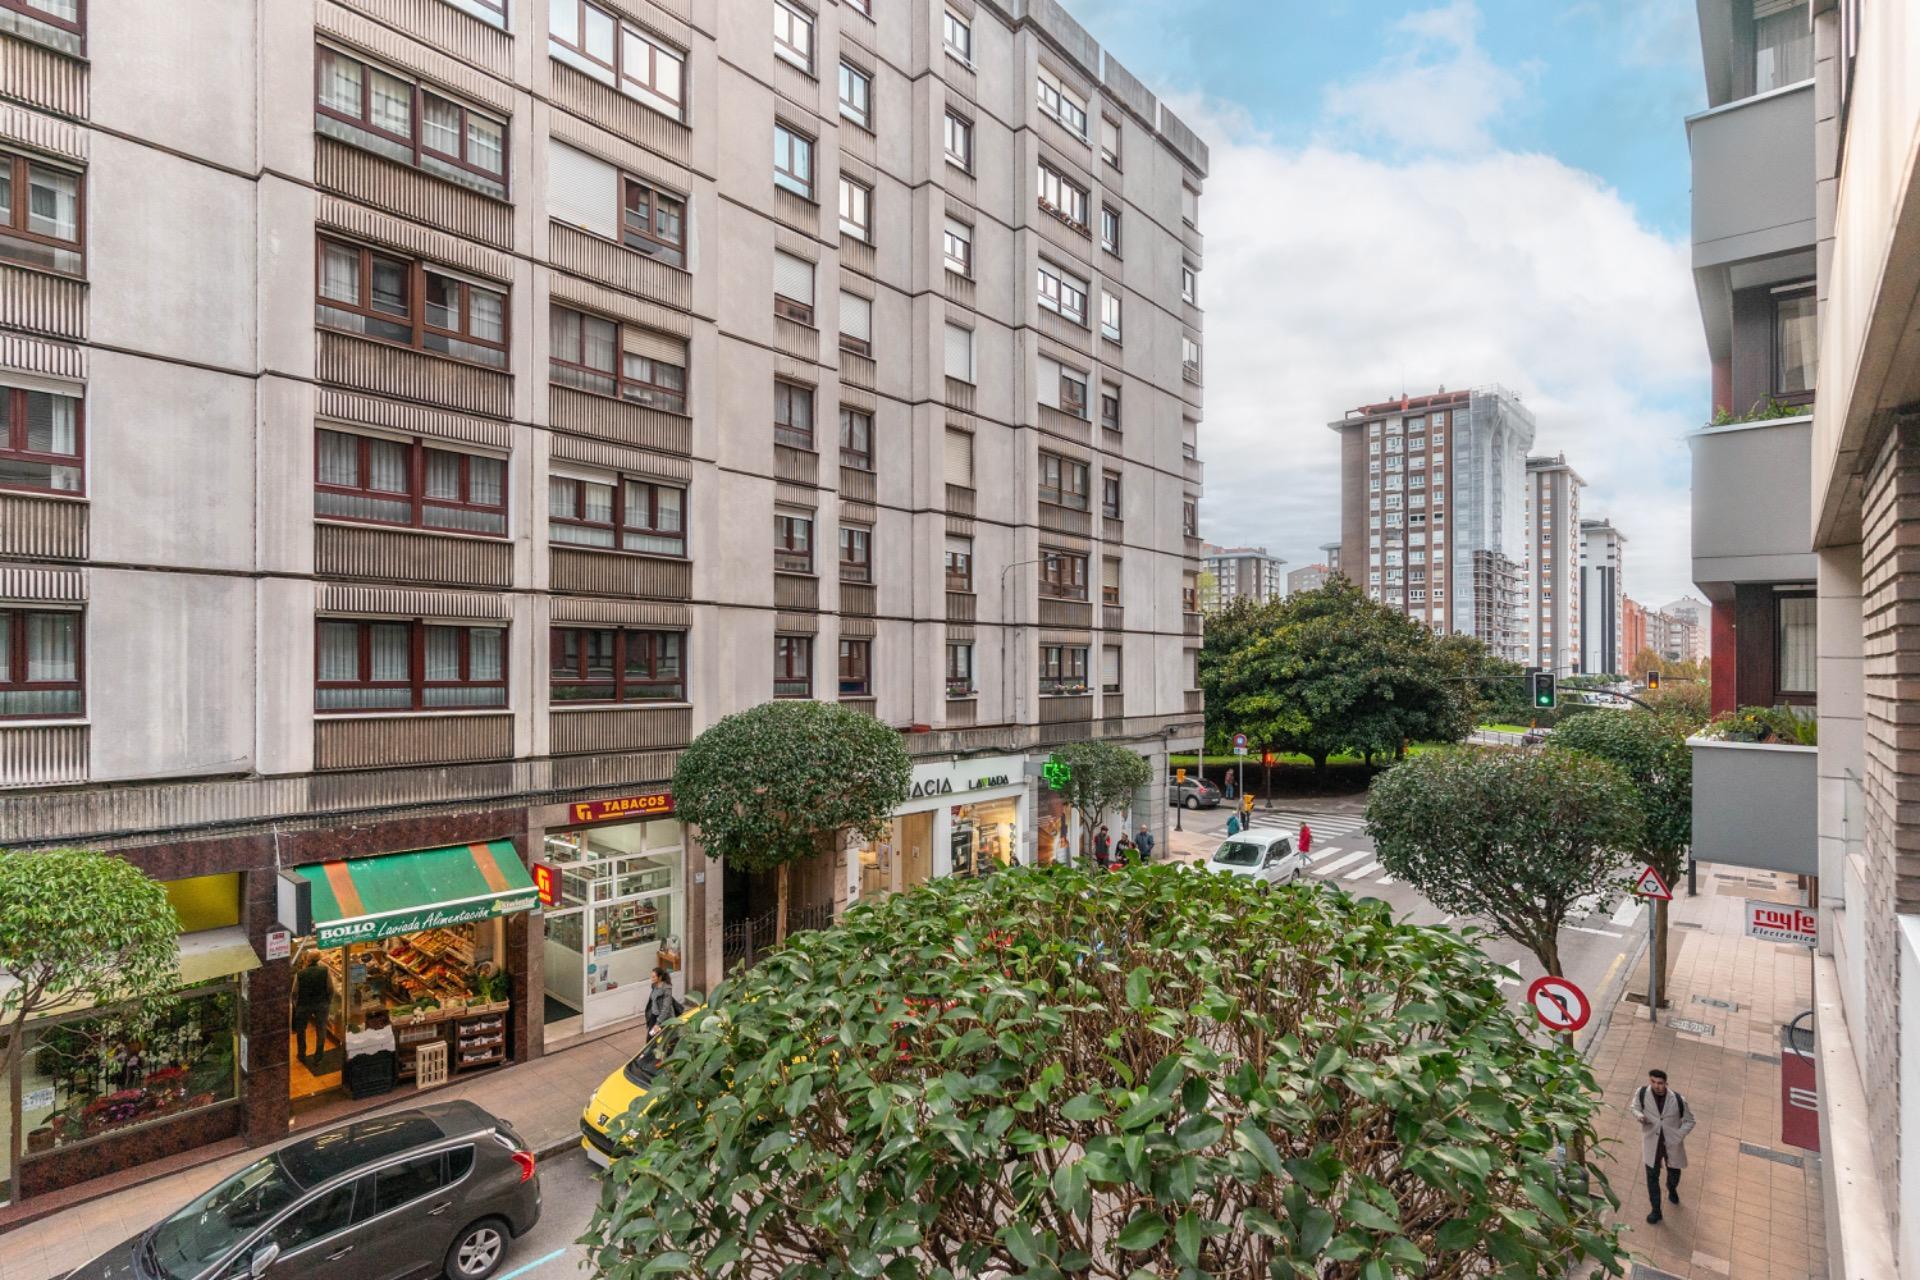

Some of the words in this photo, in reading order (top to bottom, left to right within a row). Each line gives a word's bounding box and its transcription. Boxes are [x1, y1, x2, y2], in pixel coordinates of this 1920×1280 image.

[908, 777, 953, 798] ACIA
[968, 774, 1010, 791] LAVIADA
[602, 795, 665, 813] TABACOS
[320, 922, 376, 940] BOLLO
[377, 916, 420, 938] Laviada
[421, 906, 491, 930] Alimentación
[1754, 909, 1815, 932] royfe
[1752, 926, 1816, 943] Electrónica
